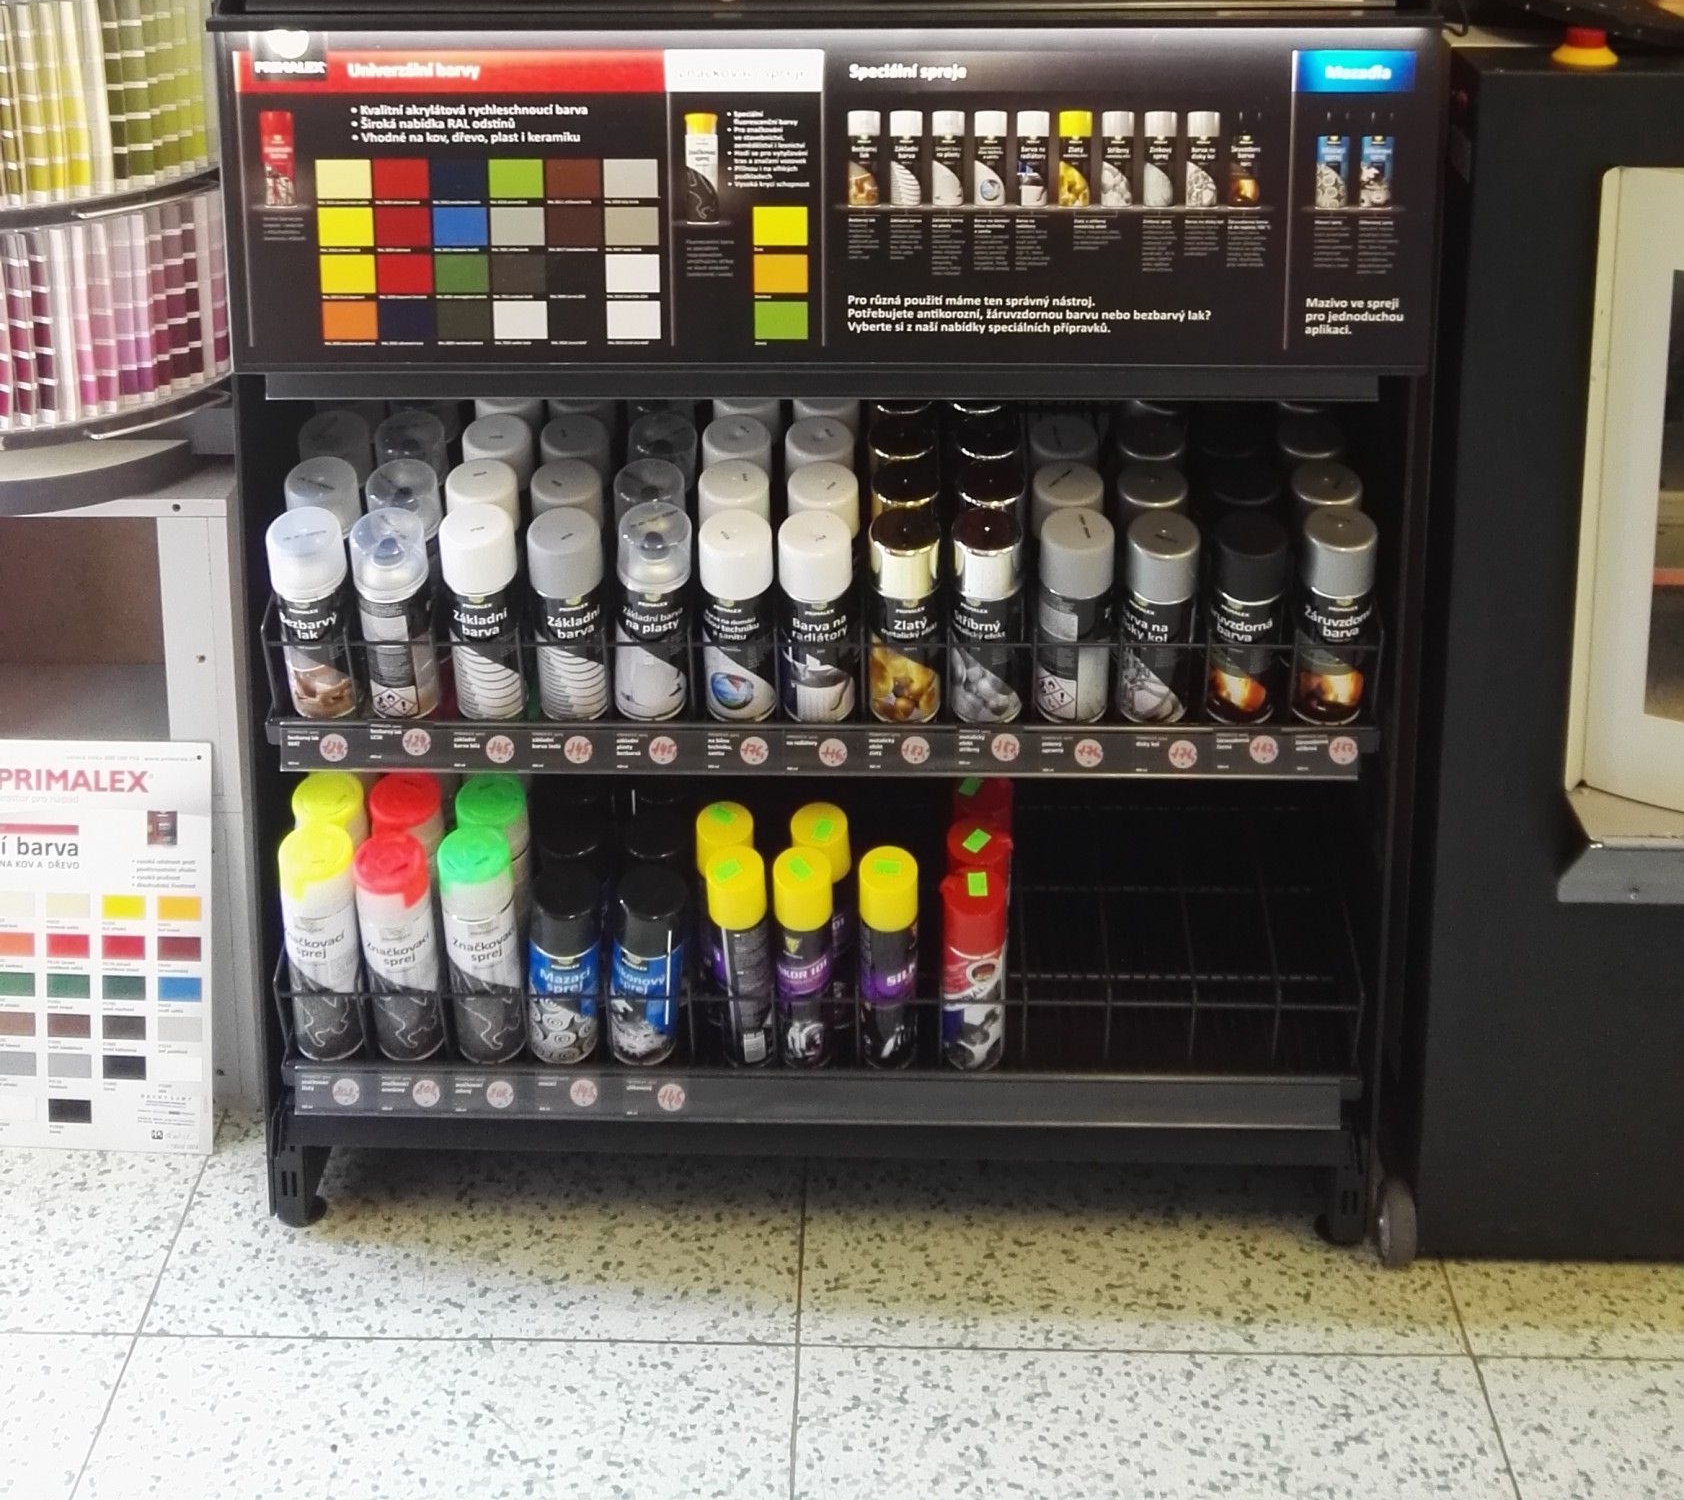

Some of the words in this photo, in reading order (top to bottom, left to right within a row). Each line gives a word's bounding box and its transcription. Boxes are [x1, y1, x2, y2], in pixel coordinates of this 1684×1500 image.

[435, 63, 480, 80] barvy
[848, 63, 917, 81] Speciální
[919, 64, 967, 82] spreje
[360, 104, 404, 116] Kvalitní
[405, 104, 466, 118] akrylátová
[468, 104, 554, 118] rychleschnoucí
[555, 104, 589, 116] barva
[360, 117, 397, 130] Široká
[398, 117, 446, 130] nabídka
[447, 118, 471, 129] RAL
[472, 117, 516, 129] odstínů
[361, 132, 406, 144] Vhodné
[408, 134, 424, 144] na
[426, 132, 450, 145] kov,
[452, 132, 488, 144] dřevo,
[490, 132, 519, 145] plast
[521, 132, 525, 143] i
[527, 132, 582, 143] keramiku
[847, 294, 867, 306] Pro
[869, 294, 901, 306] různá
[904, 294, 943, 308] použití
[945, 295, 982, 306] máme
[983, 296, 1003, 306] ten
[1005, 295, 1050, 309] správný
[1052, 295, 1096, 309] nástroj.
[1305, 297, 1348, 309] Mazivo
[1350, 300, 1364, 309] ve
[1366, 298, 1400, 311] spreji
[847, 308, 914, 320] Potřebujete
[917, 308, 984, 320] antikorozní,
[986, 308, 1063, 320] žáruvzdornou
[1065, 309, 1099, 320] barvu
[1101, 309, 1131, 320] nebo
[1133, 309, 1185, 323] bezbarvý
[1187, 309, 1212, 321] lak?
[1304, 312, 1326, 325] pro
[1327, 311, 1405, 324] jednoduchou
[847, 321, 893, 334] Vyberte
[895, 321, 904, 332] si
[906, 323, 913, 332] z
[914, 321, 939, 332] naší
[940, 321, 986, 335] nabídky
[988, 321, 1051, 335] speciálních
[1053, 322, 1112, 336] přípravků.
[1304, 324, 1353, 337] aplikaci.
[452, 607, 508, 626] Základní
[792, 617, 830, 633] Barva
[833, 615, 847, 627] na
[893, 616, 928, 631] Zlatý
[461, 624, 500, 638] barva
[556, 624, 595, 640] barva
[625, 618, 641, 631] na
[642, 618, 680, 634] plasty
[1151, 622, 1169, 633] na
[1215, 623, 1252, 643] barva
[1321, 626, 1360, 639] barva
[297, 629, 319, 640] lak
[791, 626, 848, 643] radiátory
[1147, 632, 1168, 643] kol
[0, 768, 149, 793] PRIMALEX
[17, 836, 80, 857] barva
[15, 861, 35, 869] KOV
[36, 861, 43, 869] A
[48, 859, 80, 870] DŘEVO
[383, 954, 417, 967] sprej
[470, 949, 503, 963] sprej
[810, 959, 828, 976] 101
[539, 966, 591, 985] Mazací
[546, 981, 583, 995] sprej
